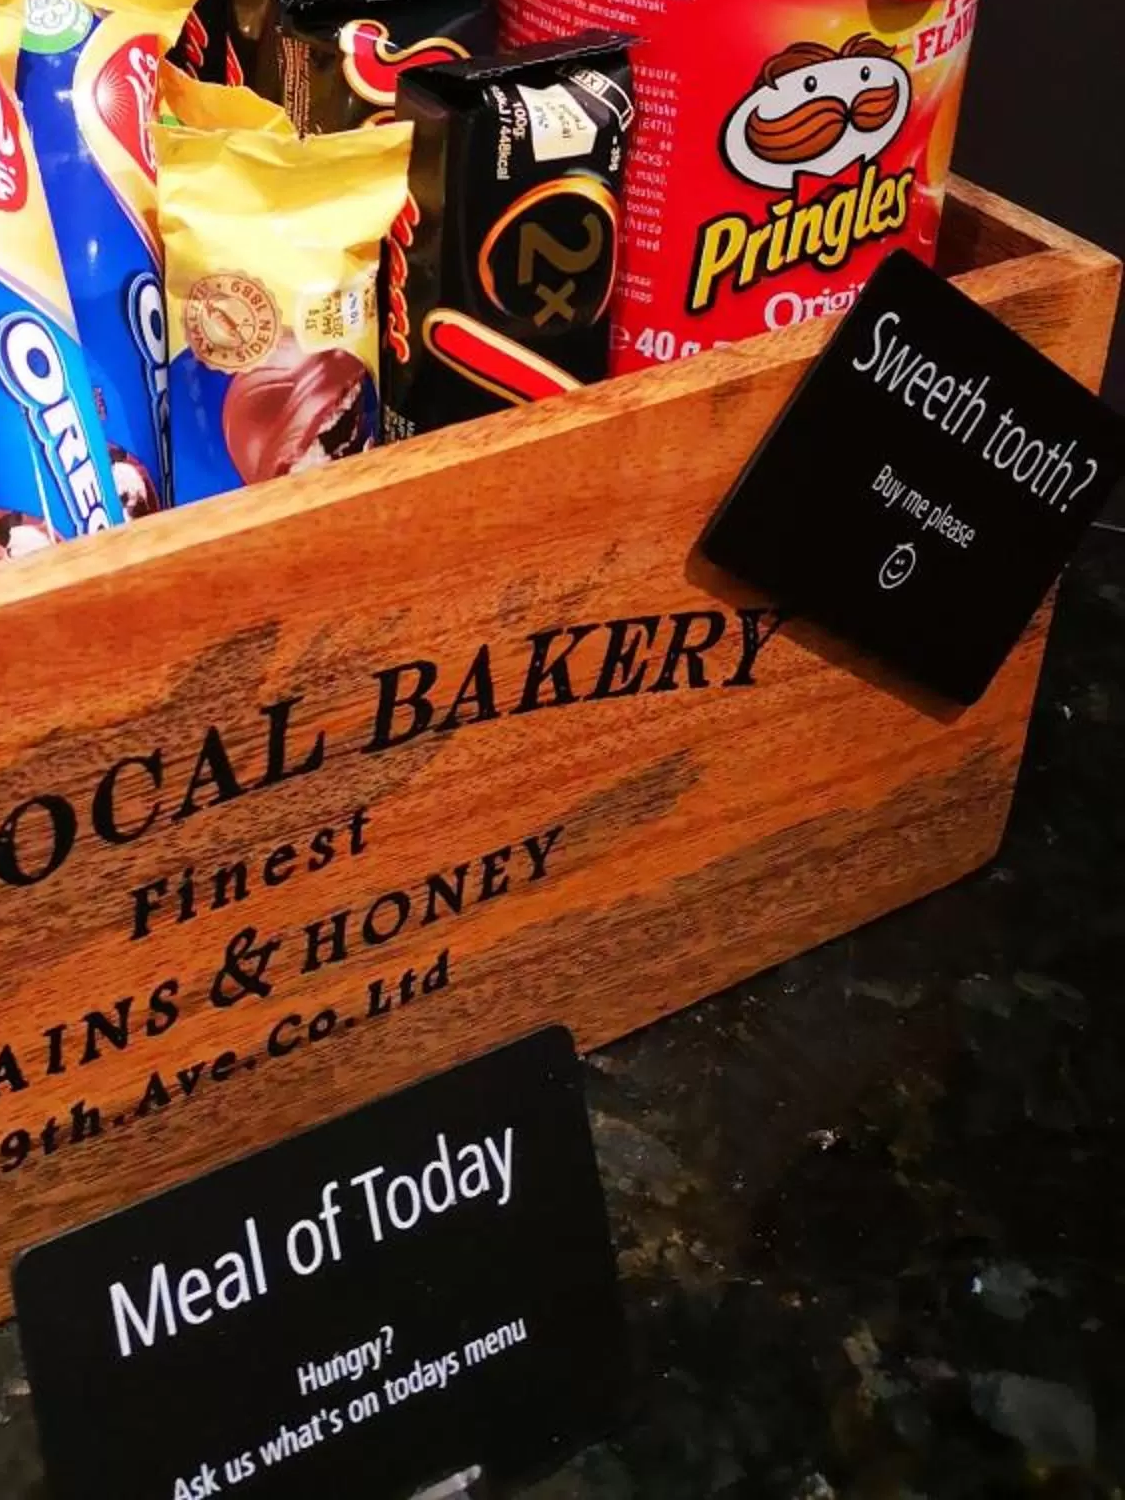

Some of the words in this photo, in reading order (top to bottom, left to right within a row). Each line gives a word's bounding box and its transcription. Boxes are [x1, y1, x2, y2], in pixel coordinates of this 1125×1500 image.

[230, 280, 268, 312] 1889
[689, 168, 914, 312] Pringles
[235, 320, 272, 362] SIDEN
[634, 327, 674, 360] 40
[852, 311, 990, 445] Sweeth
[981, 407, 1099, 514] tooth?
[872, 463, 904, 509] Buy
[902, 483, 929, 520] me
[922, 501, 977, 550] please
[360, 606, 783, 756] BAKERY
[129, 804, 374, 944] Finest
[210, 925, 283, 1010] &
[301, 824, 565, 977] HONEY
[108, 1216, 269, 1358] Meal
[285, 1181, 343, 1277] of
[350, 1126, 516, 1243] Today
[173, 1462, 221, 1500] Ask
[224, 1451, 257, 1485] us
[259, 1407, 345, 1467] what's
[348, 1390, 381, 1424] on
[384, 1349, 461, 1406] todays
[465, 1315, 528, 1368] menu
[296, 1324, 396, 1397] Hungry?
